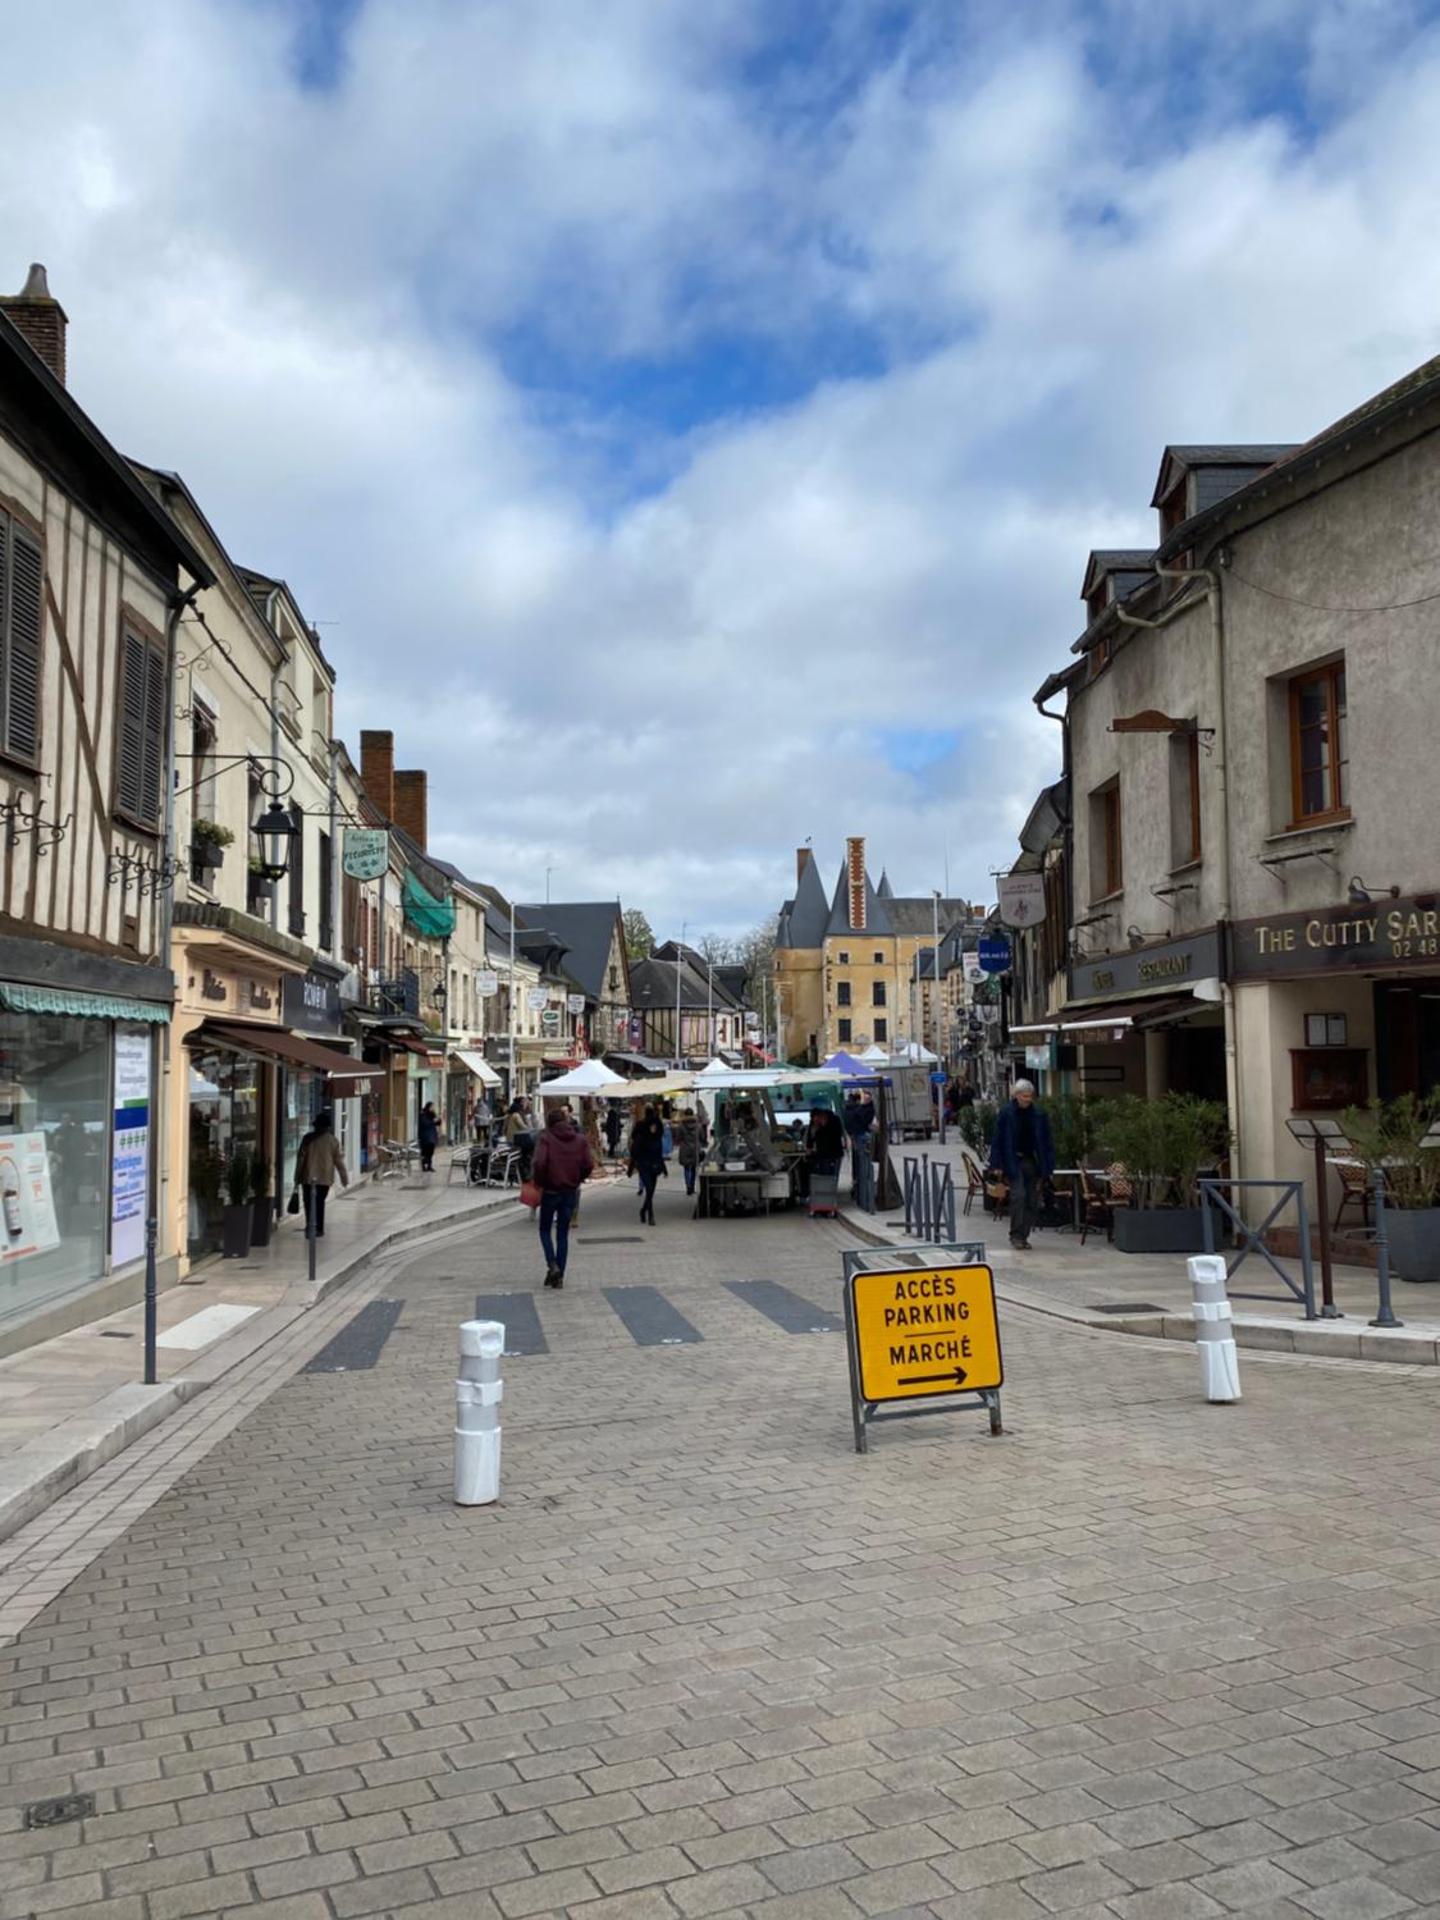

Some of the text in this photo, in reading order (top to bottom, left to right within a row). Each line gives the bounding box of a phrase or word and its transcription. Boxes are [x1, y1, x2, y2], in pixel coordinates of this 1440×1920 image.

[1255, 926, 1296, 954] THE
[1306, 918, 1378, 948] CUTTY
[1393, 938, 1437, 958] 02 48
[896, 1274, 956, 1300] ACCÈS
[884, 1302, 969, 1327] PARKING
[890, 1335, 972, 1365] MARCHÉ
